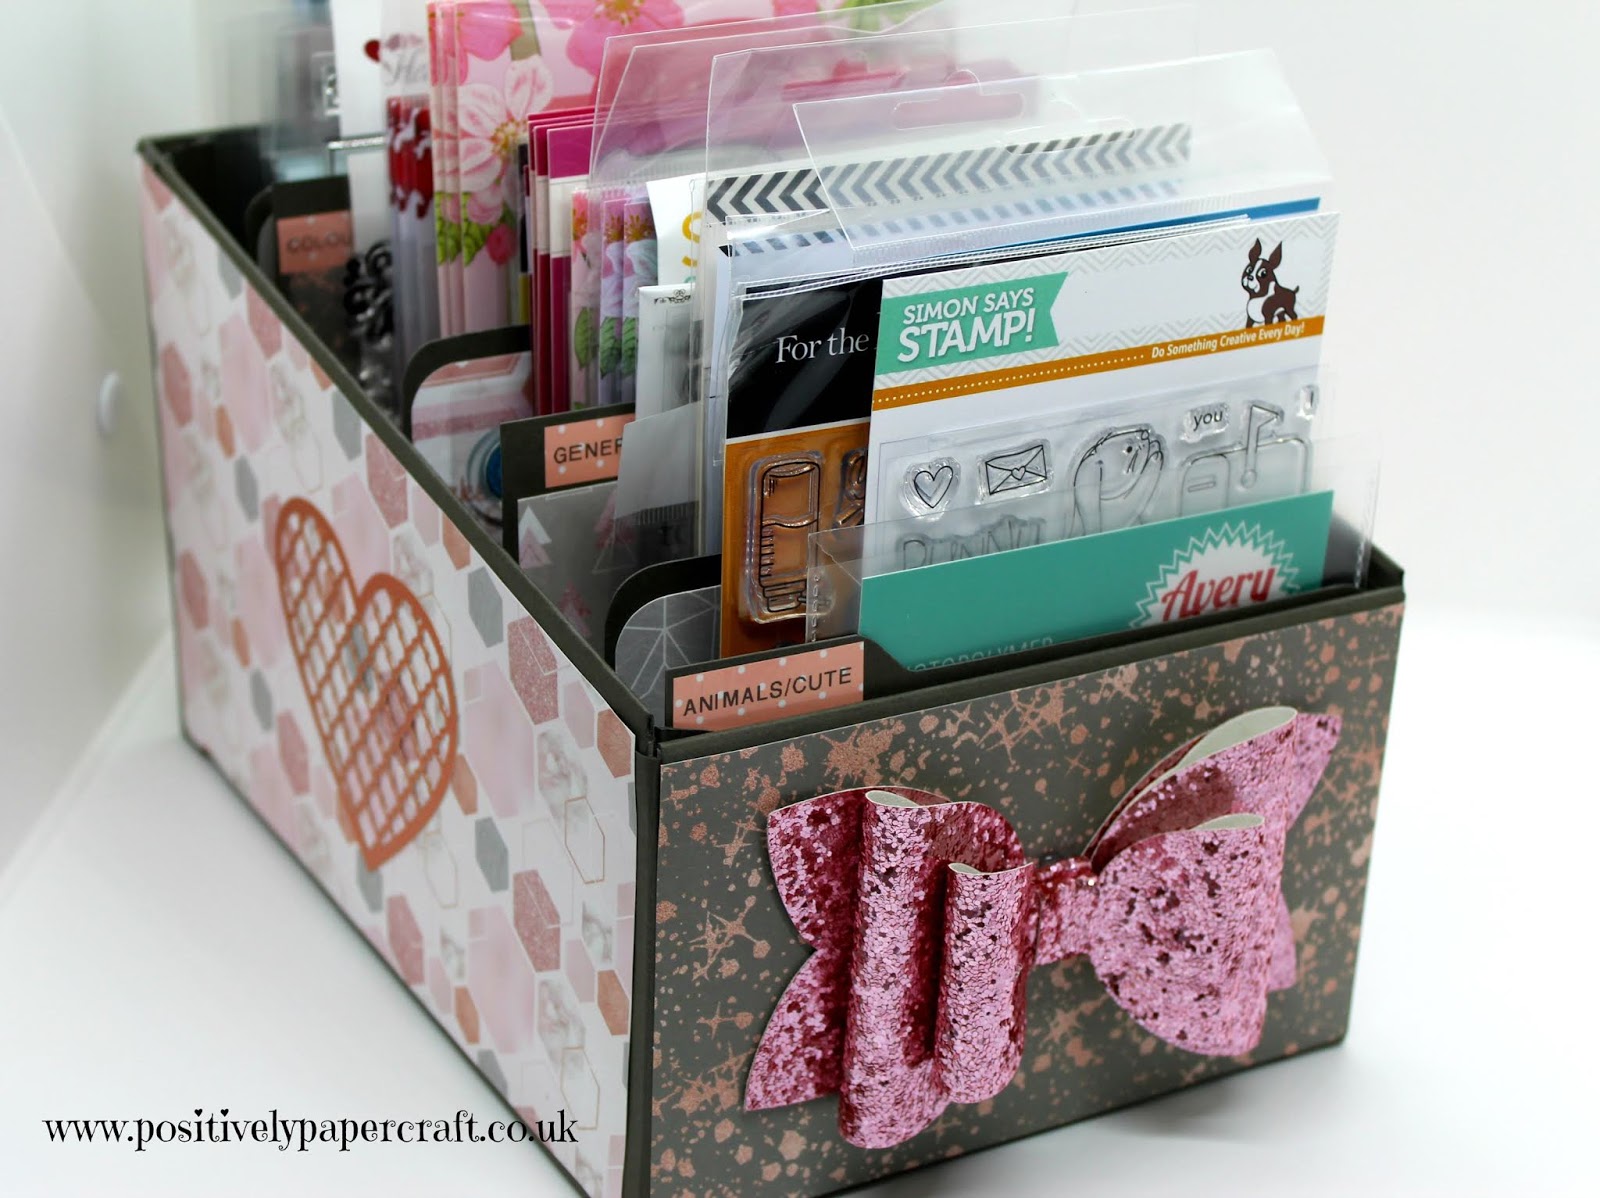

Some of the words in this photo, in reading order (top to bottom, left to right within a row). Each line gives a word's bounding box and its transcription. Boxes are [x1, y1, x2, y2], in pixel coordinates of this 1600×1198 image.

[903, 295, 979, 325] SIMON
[983, 287, 1035, 313] SAYS
[775, 334, 822, 364] For
[827, 327, 870, 356] the
[897, 307, 1036, 363] STAMP!
[1151, 346, 1165, 359] Do
[1167, 338, 1218, 357] Something
[1220, 331, 1257, 347] Creative
[1258, 326, 1283, 341] Every
[1284, 322, 1306, 337] Day!
[1193, 411, 1223, 432] you
[683, 666, 853, 717] ANIMALS/CUTE
